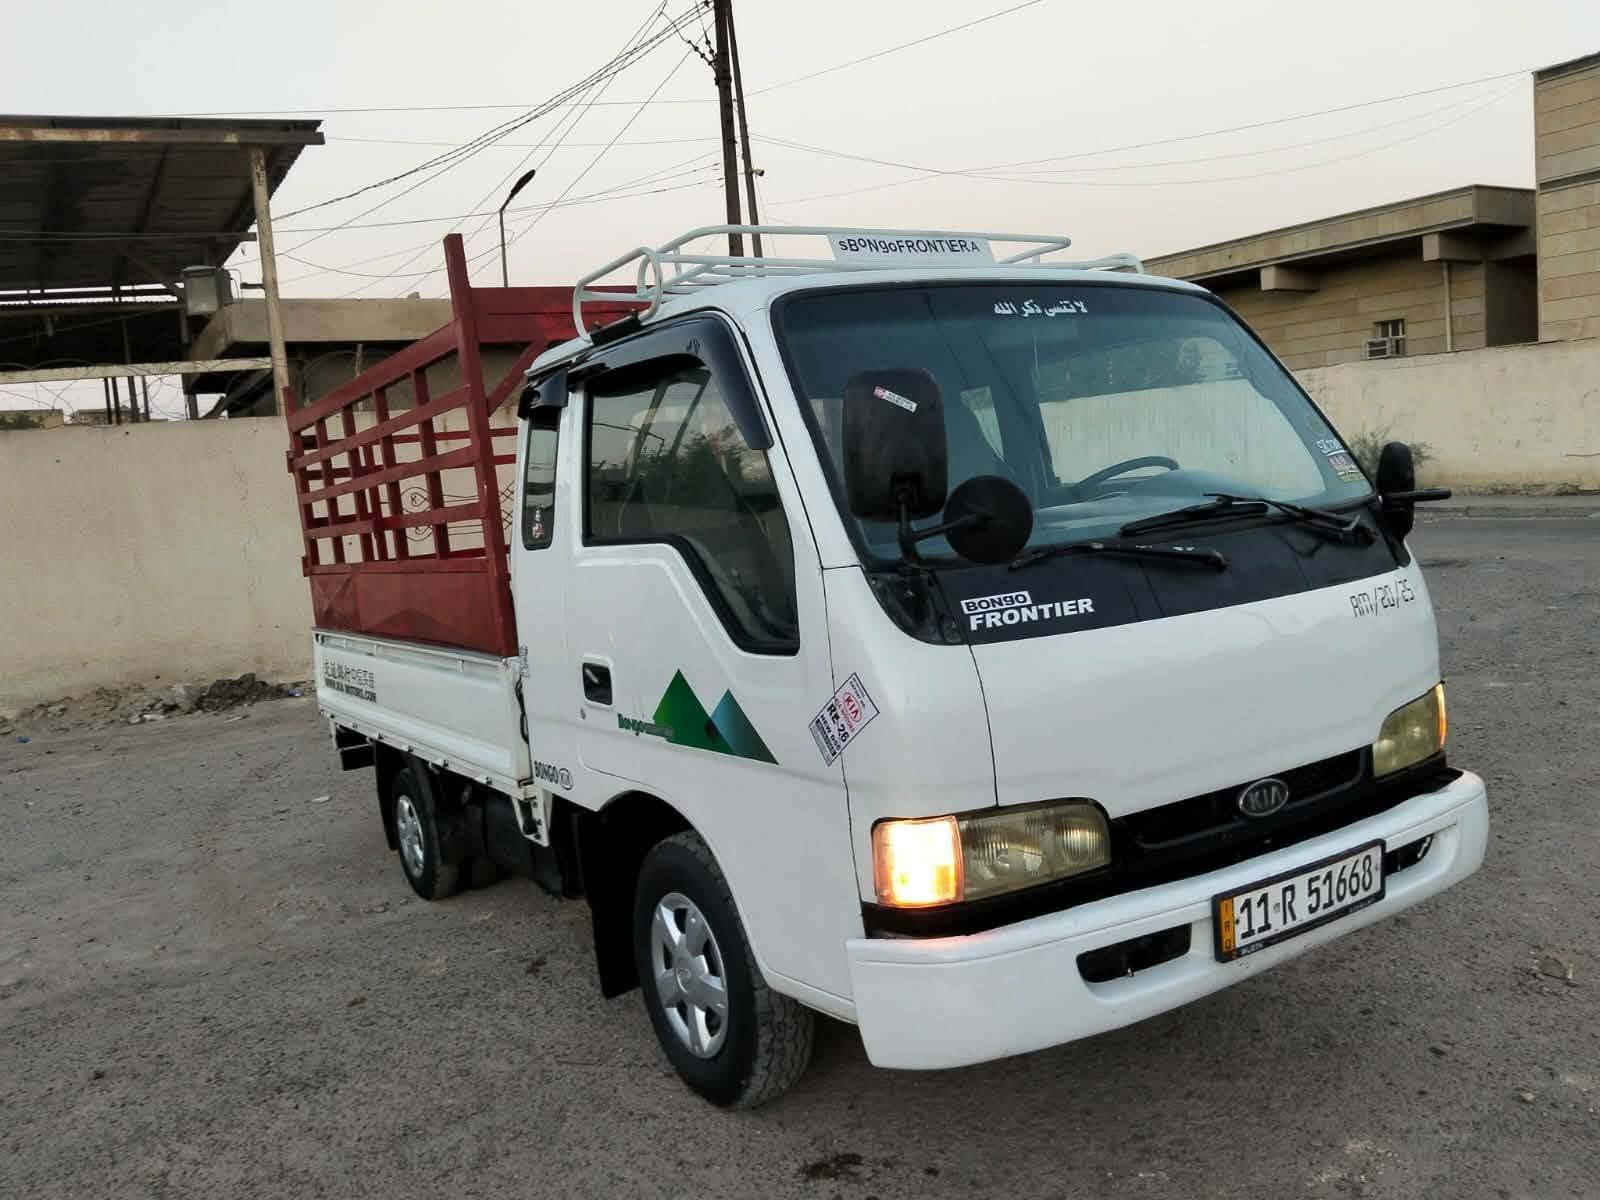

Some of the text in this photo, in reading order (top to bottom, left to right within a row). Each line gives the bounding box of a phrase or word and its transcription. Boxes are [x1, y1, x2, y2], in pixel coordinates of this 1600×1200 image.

[993, 301, 1018, 315] الله
[969, 598, 1095, 631] FRONTIER
[845, 695, 859, 719] KIA
[1247, 785, 1282, 811] KIA
[1240, 854, 1373, 939] 11 R 51668
